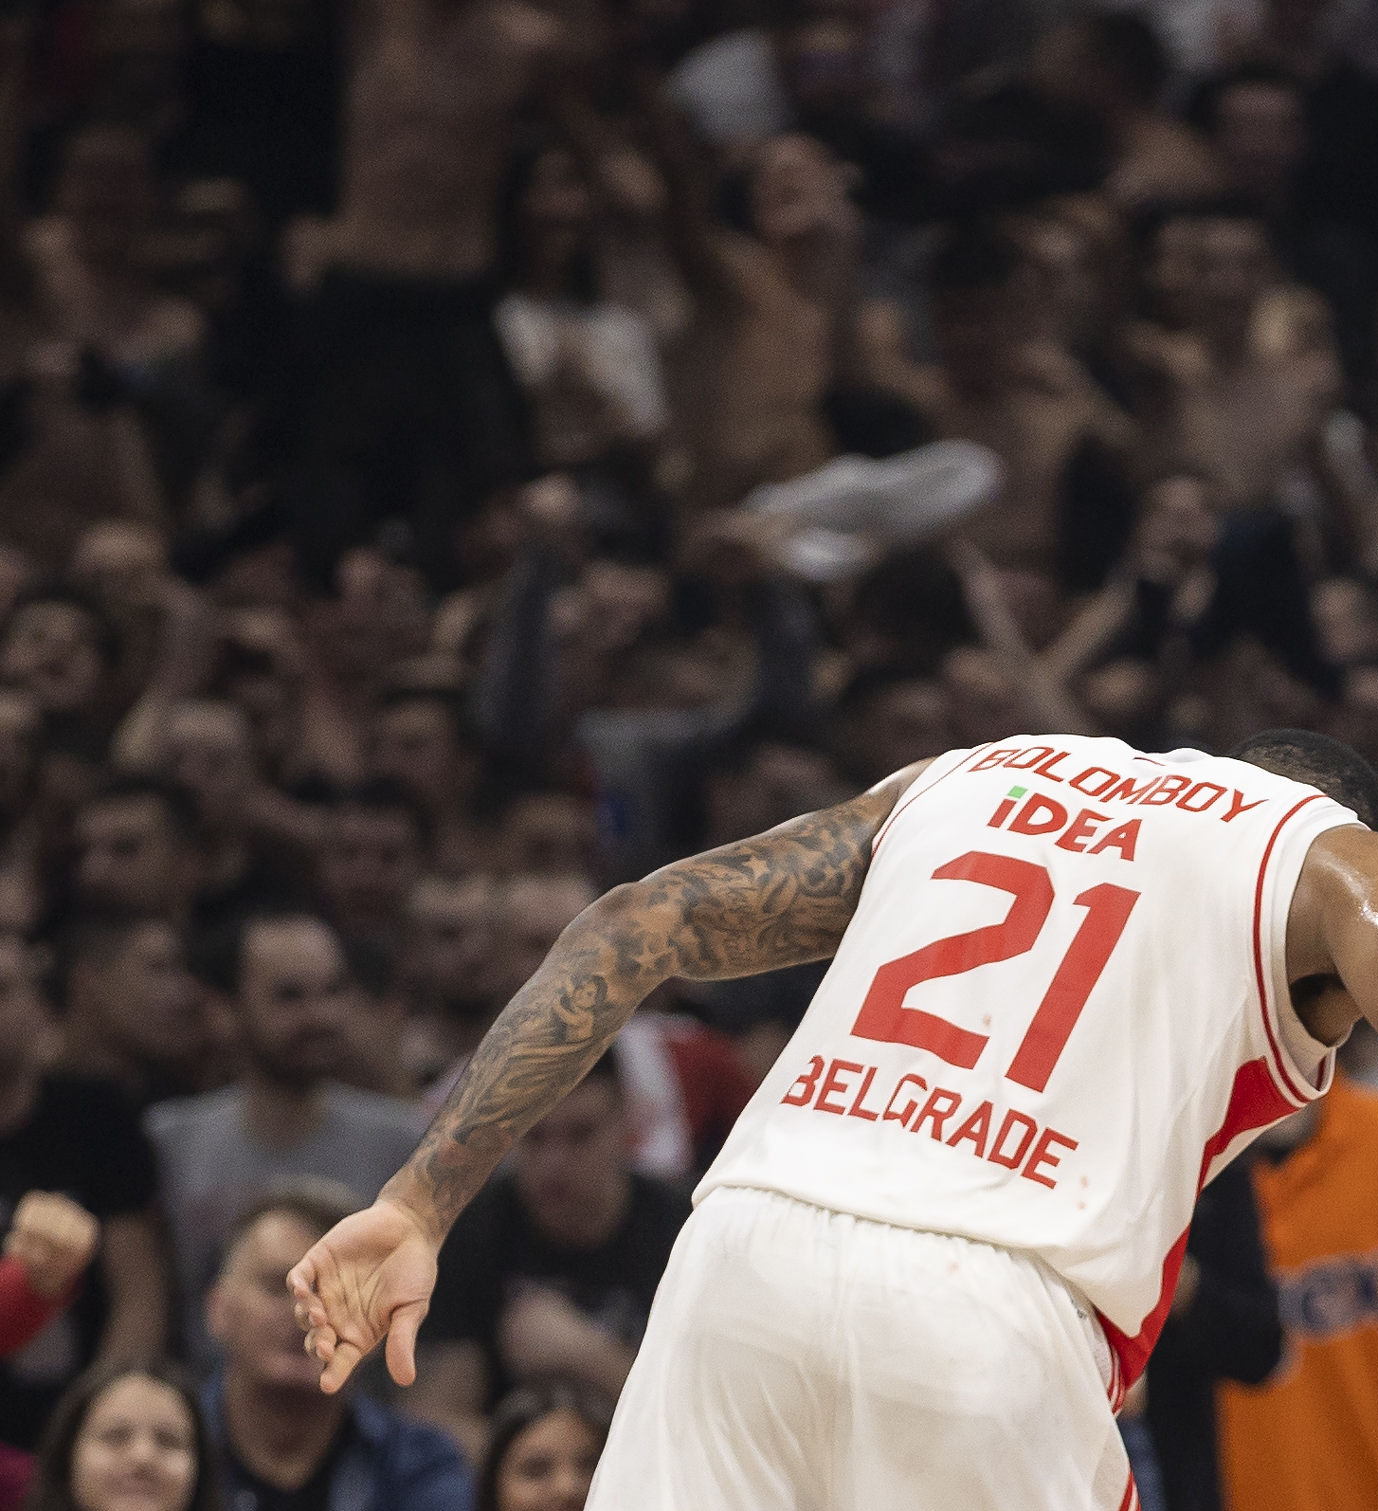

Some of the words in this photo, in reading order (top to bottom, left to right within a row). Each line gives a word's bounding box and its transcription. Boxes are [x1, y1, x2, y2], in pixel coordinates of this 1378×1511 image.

[967, 746, 1269, 823] BOLOMBOY
[850, 850, 1142, 1094] 21
[780, 1055, 1079, 1190] BELGRADE
